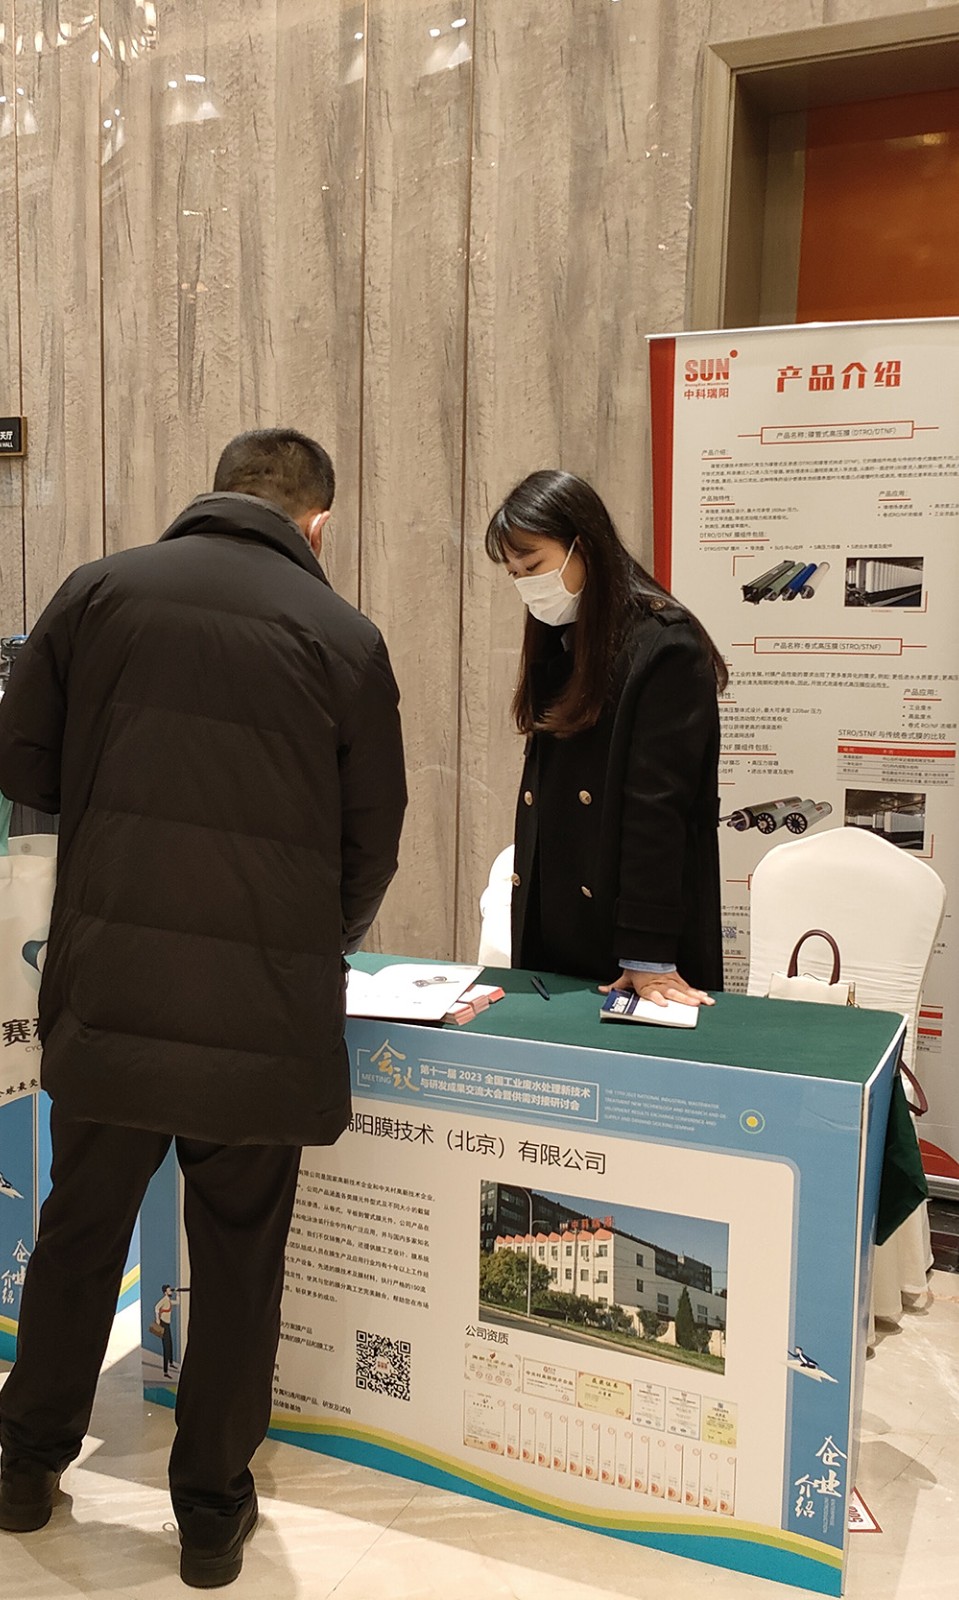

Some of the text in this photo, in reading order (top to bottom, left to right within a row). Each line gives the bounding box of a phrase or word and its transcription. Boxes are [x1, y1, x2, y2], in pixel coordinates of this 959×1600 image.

[685, 358, 729, 382] SUN
[777, 361, 901, 392] 产品介绍
[684, 388, 729, 400] 中科瑞阳
[362, 1073, 392, 1084] MEETING
[370, 1039, 420, 1092] 会议
[420, 1064, 591, 1098] 第十一届 2023 全国工业废水处理新技术
[420, 1078, 580, 1111] 与研发成果交流大会暨供需对接研讨会
[465, 1324, 510, 1346] 公司资质
